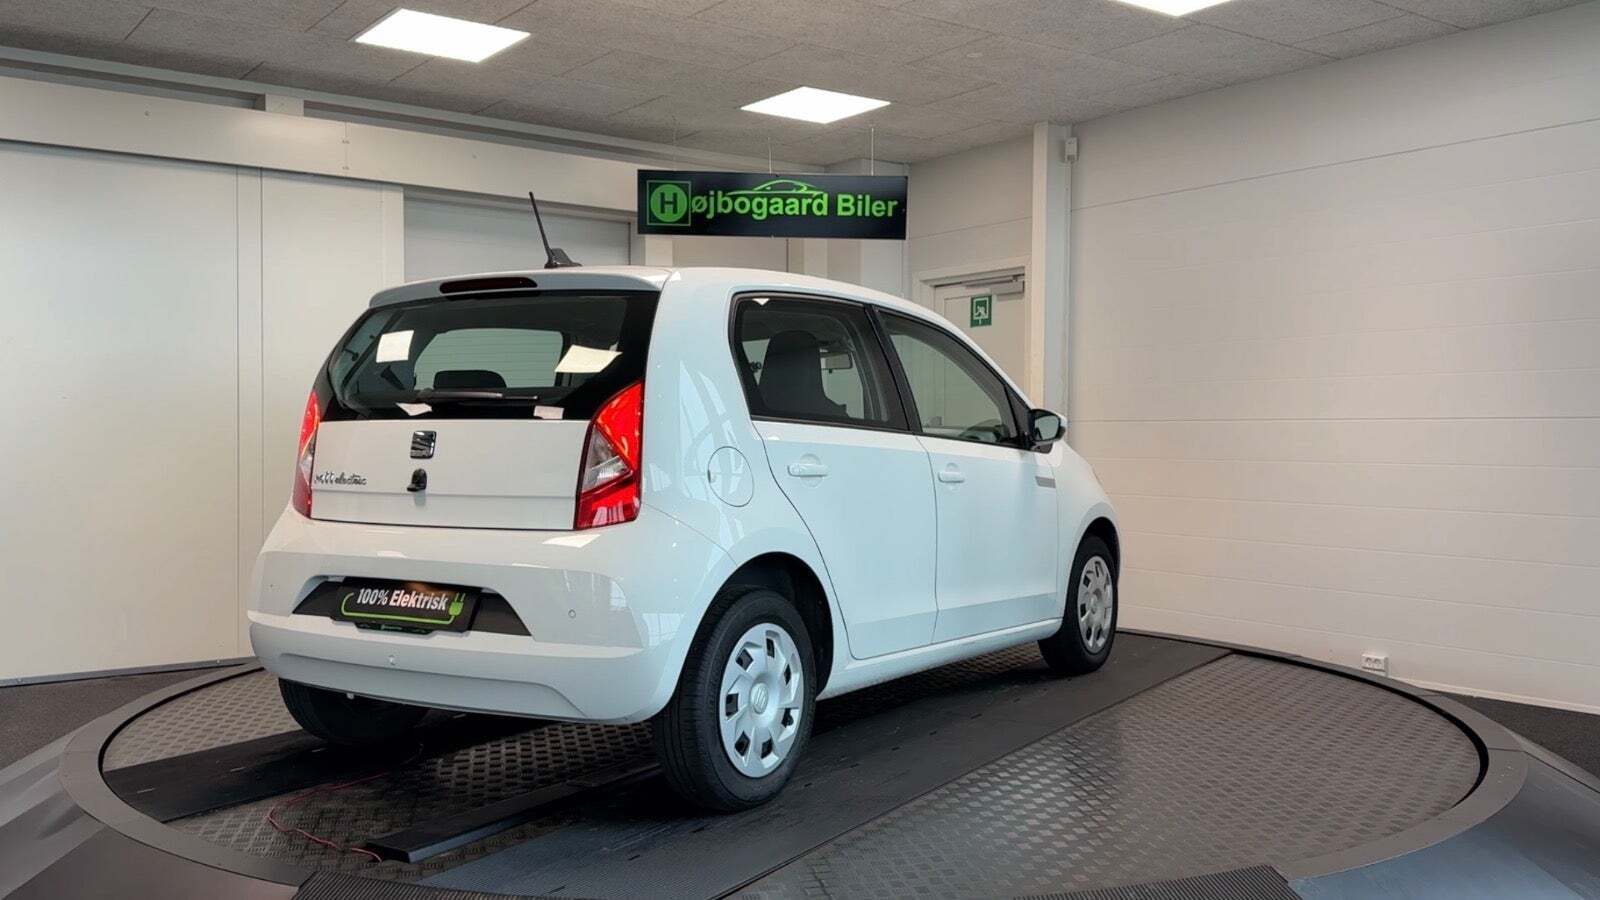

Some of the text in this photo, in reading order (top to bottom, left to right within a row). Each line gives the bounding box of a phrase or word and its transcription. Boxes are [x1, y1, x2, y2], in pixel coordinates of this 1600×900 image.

[836, 193, 899, 217] Biler
[356, 587, 449, 611] 100% Elektrisk
